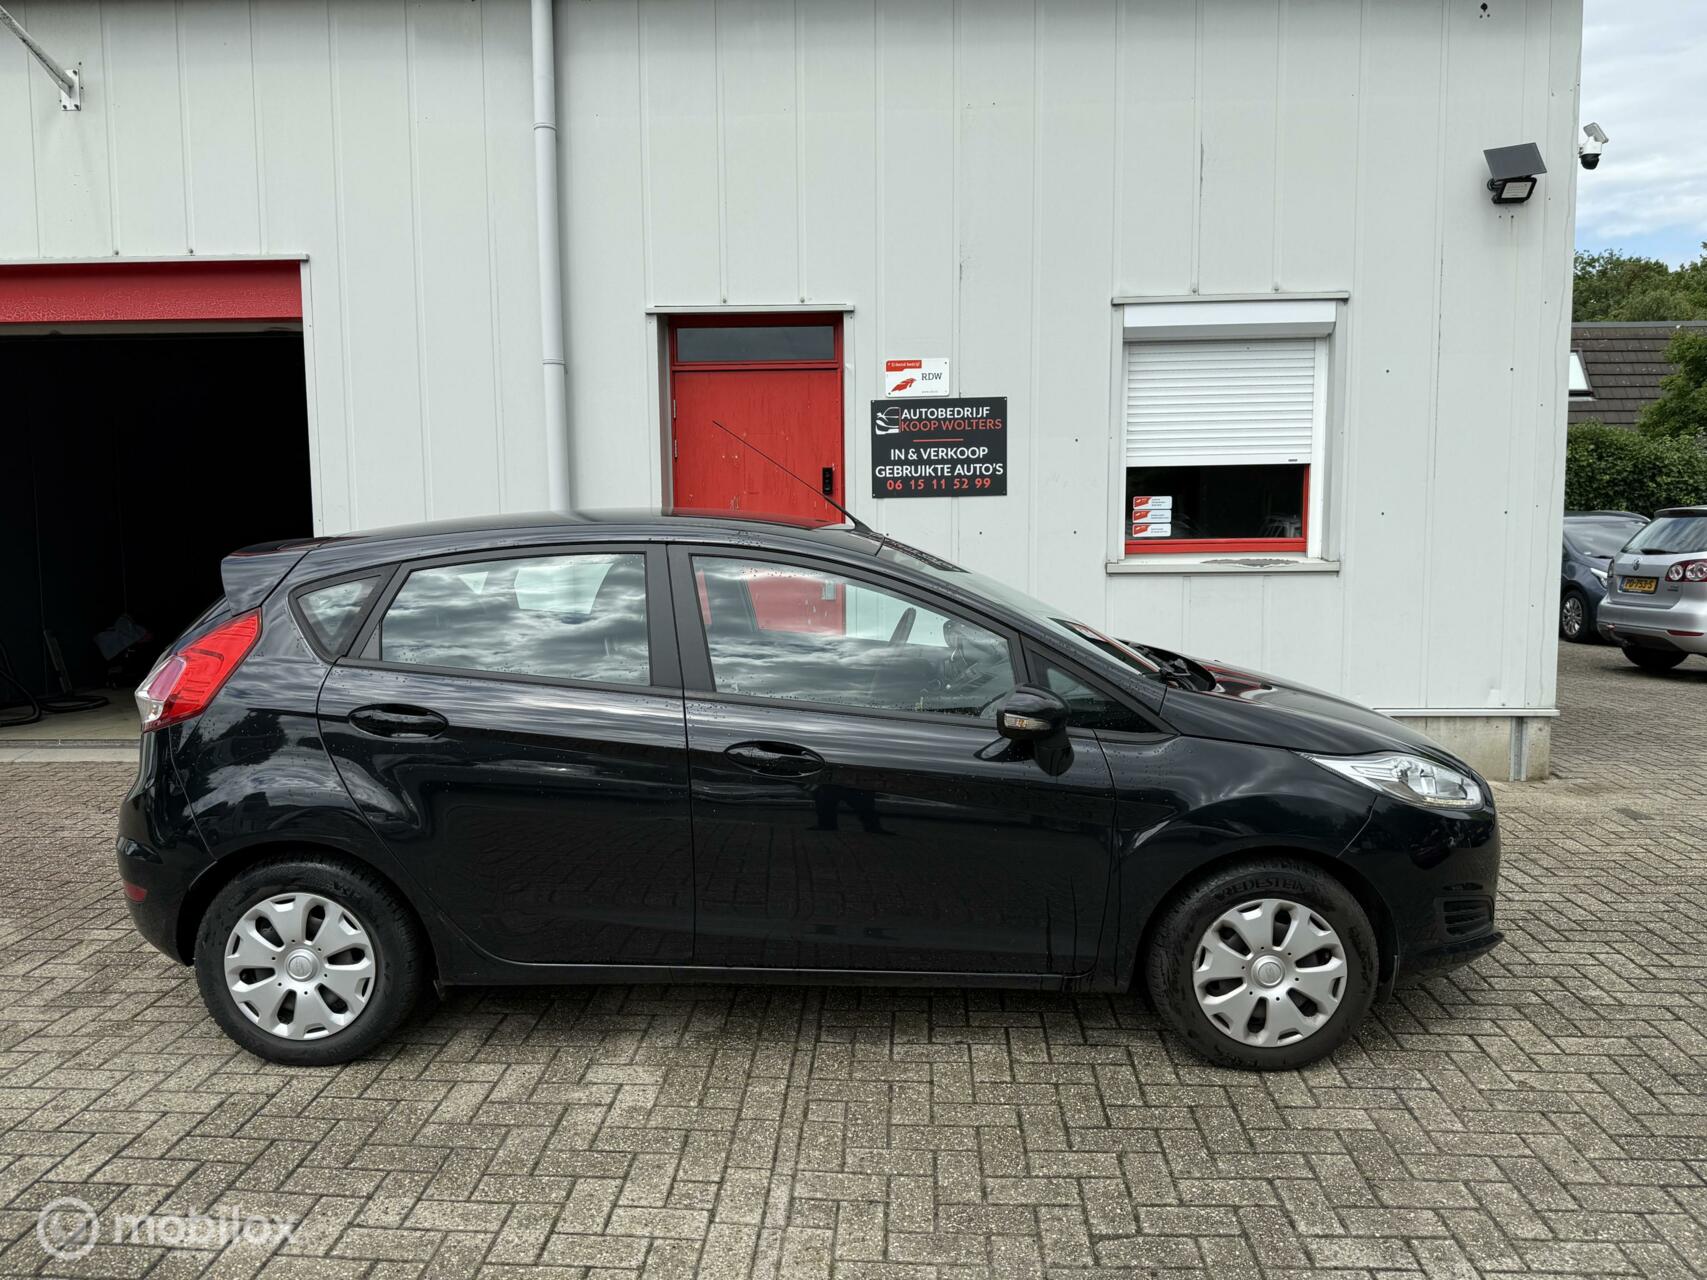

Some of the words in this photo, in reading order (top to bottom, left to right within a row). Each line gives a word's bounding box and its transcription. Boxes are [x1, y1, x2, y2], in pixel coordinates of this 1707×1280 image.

[921, 372, 942, 381] RDW
[901, 407, 990, 419] AUTOBEDRIJF
[901, 420, 939, 432] KOOP
[941, 419, 1002, 430] WOLTERS
[890, 448, 905, 460] IN
[907, 448, 918, 460] &
[920, 446, 989, 460] VERKOOP
[875, 464, 952, 478] GEBRUIKTE
[954, 463, 1004, 476] AUTO'S
[887, 480, 902, 490] 06
[909, 479, 925, 490] 15
[932, 479, 945, 489] 11
[953, 478, 969, 489] 52
[975, 478, 991, 489] 99
